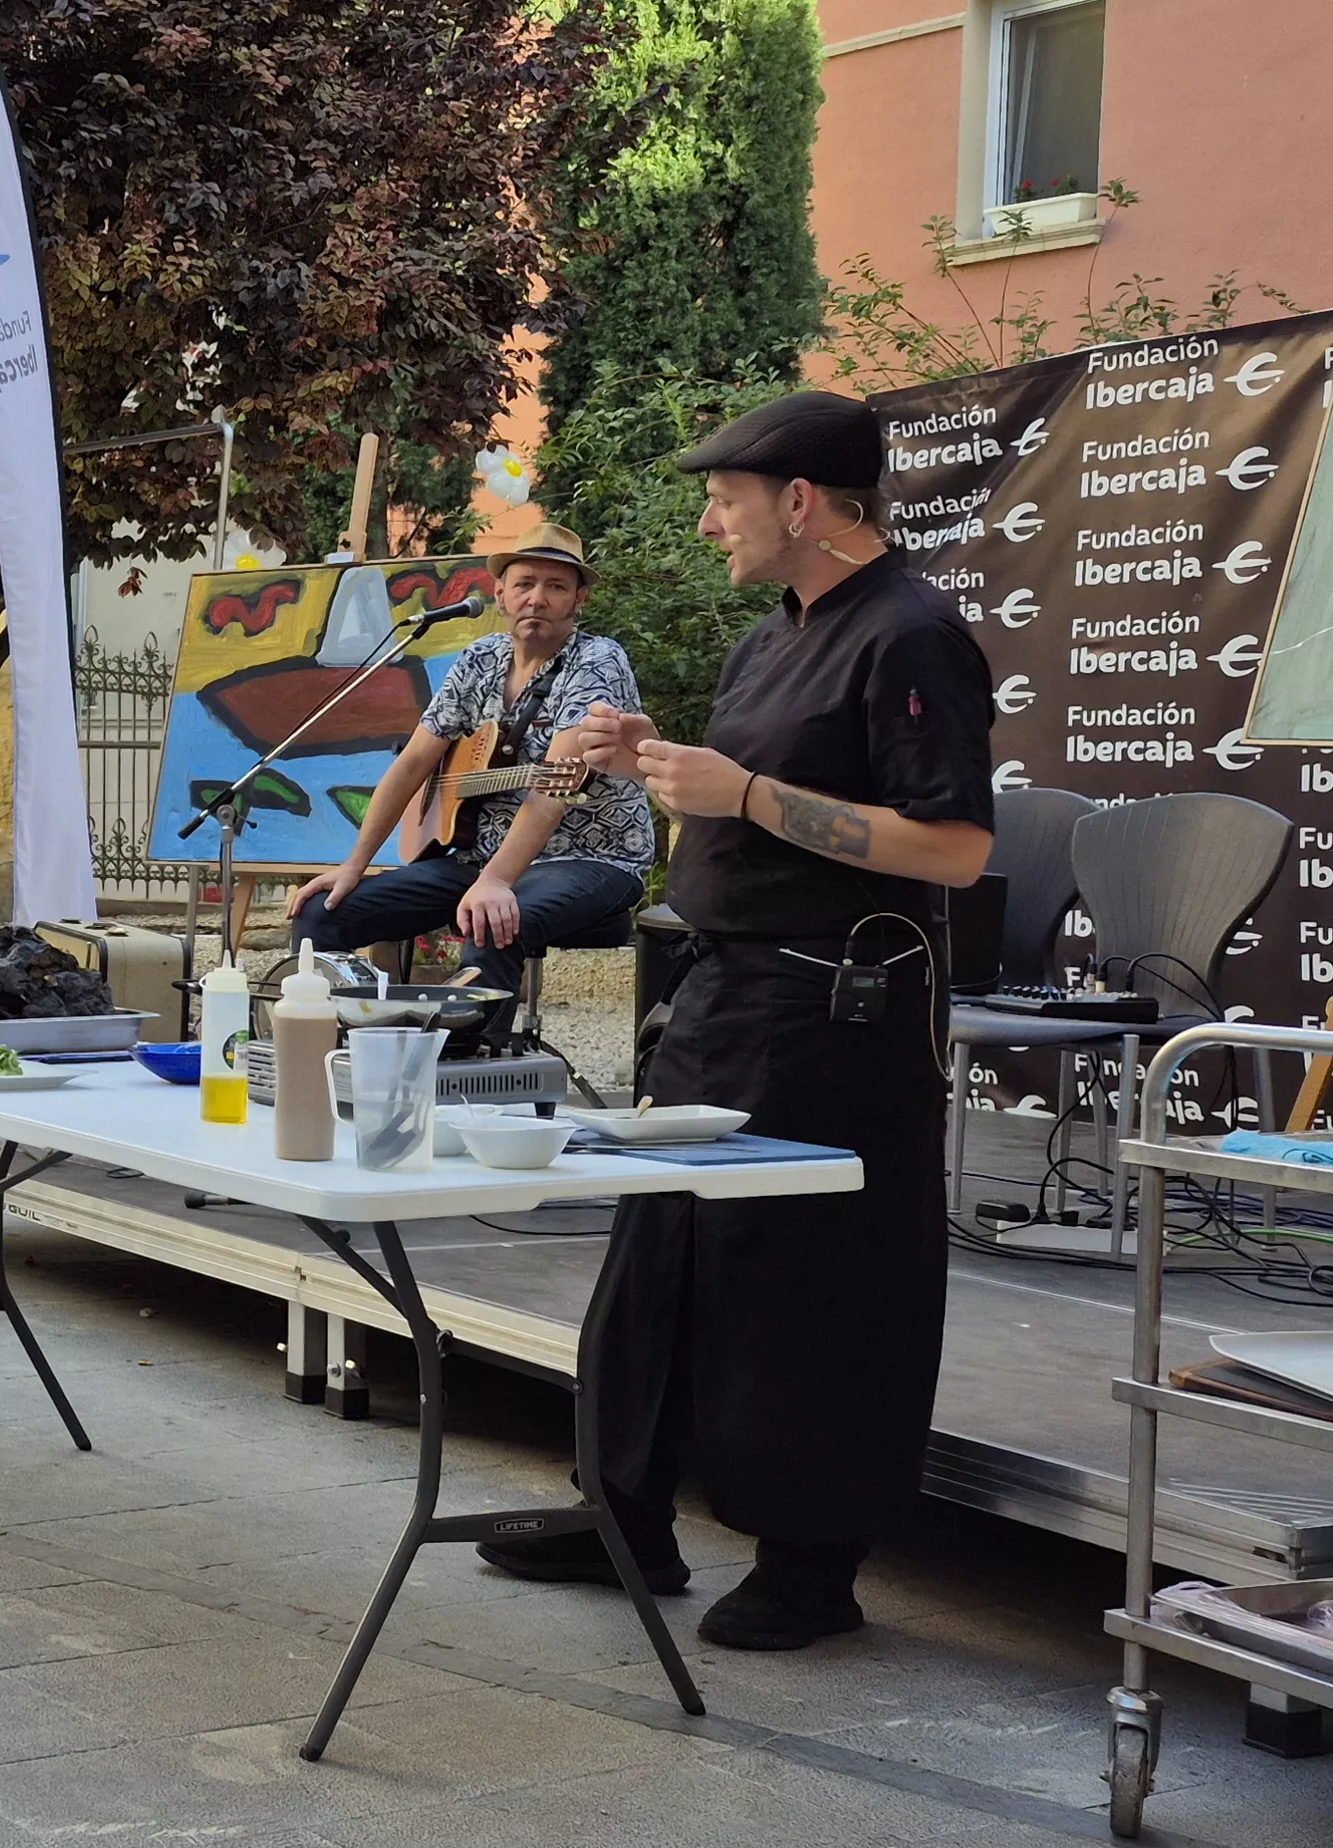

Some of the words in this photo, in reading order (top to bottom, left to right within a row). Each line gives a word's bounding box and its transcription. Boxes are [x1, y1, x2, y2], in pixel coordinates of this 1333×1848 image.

[1087, 336, 1219, 374] Fundación
[1085, 366, 1215, 410] Ibercaja
[888, 404, 997, 440] Fundación
[887, 433, 1003, 473] Ibercaja
[1082, 426, 1210, 463] Fundación
[1079, 457, 1207, 500] Ibercaja
[1076, 519, 1204, 552] Fundación
[1074, 549, 1203, 587] Ibercaja
[1071, 610, 1200, 639] Fundación
[1069, 640, 1198, 677] Ibercaja
[1067, 701, 1196, 727] Fundación
[1066, 731, 1195, 768] Ibercaja
[8, 1204, 41, 1221] GUIL
[500, 1521, 538, 1530] LIFETIME
